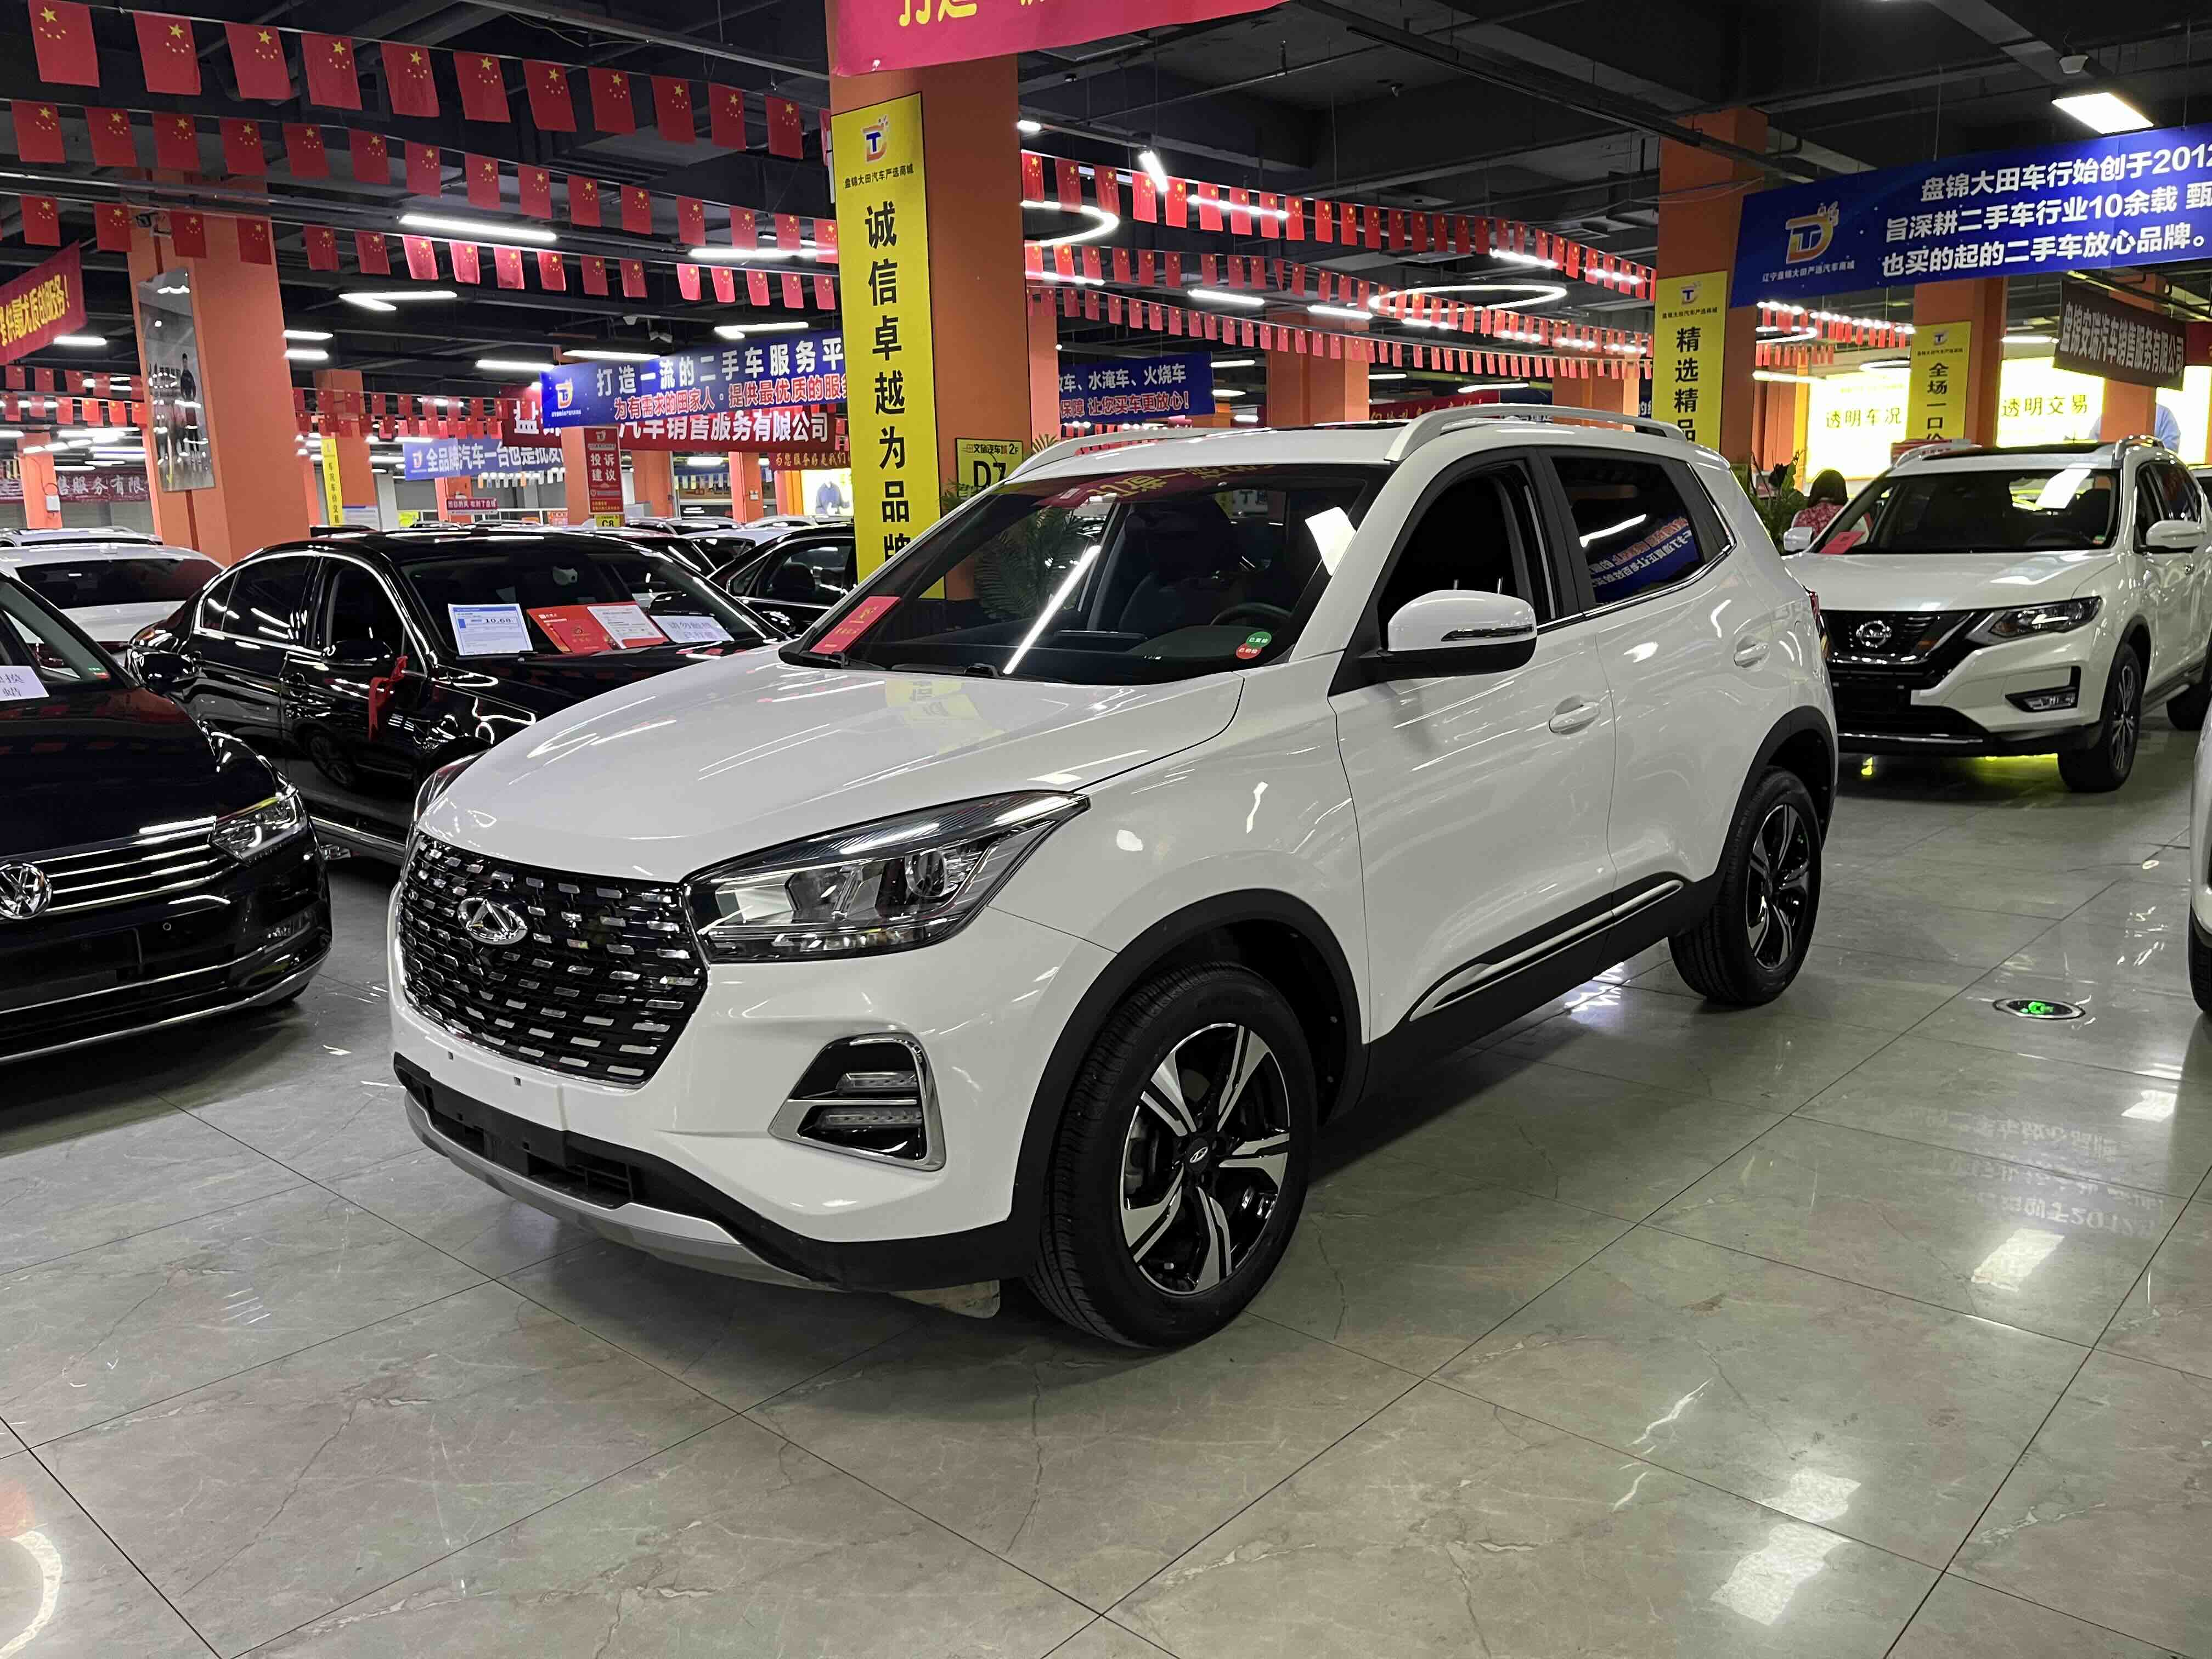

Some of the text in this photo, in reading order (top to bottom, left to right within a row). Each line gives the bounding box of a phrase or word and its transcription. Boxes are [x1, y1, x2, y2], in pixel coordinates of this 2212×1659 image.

[1886, 185, 2177, 243] 旨深耕二手车行业10余载
[1882, 222, 2205, 277] 也买的起的二手车放心品牌。
[596, 337, 844, 397] 打造一流的二手车服务平
[865, 200, 911, 562] 诚信卓越为品牌
[1674, 327, 1701, 442] 精选精品
[1826, 407, 1901, 428] 透明车况
[2001, 394, 2089, 417] 透明交易
[973, 460, 1006, 488] D7
